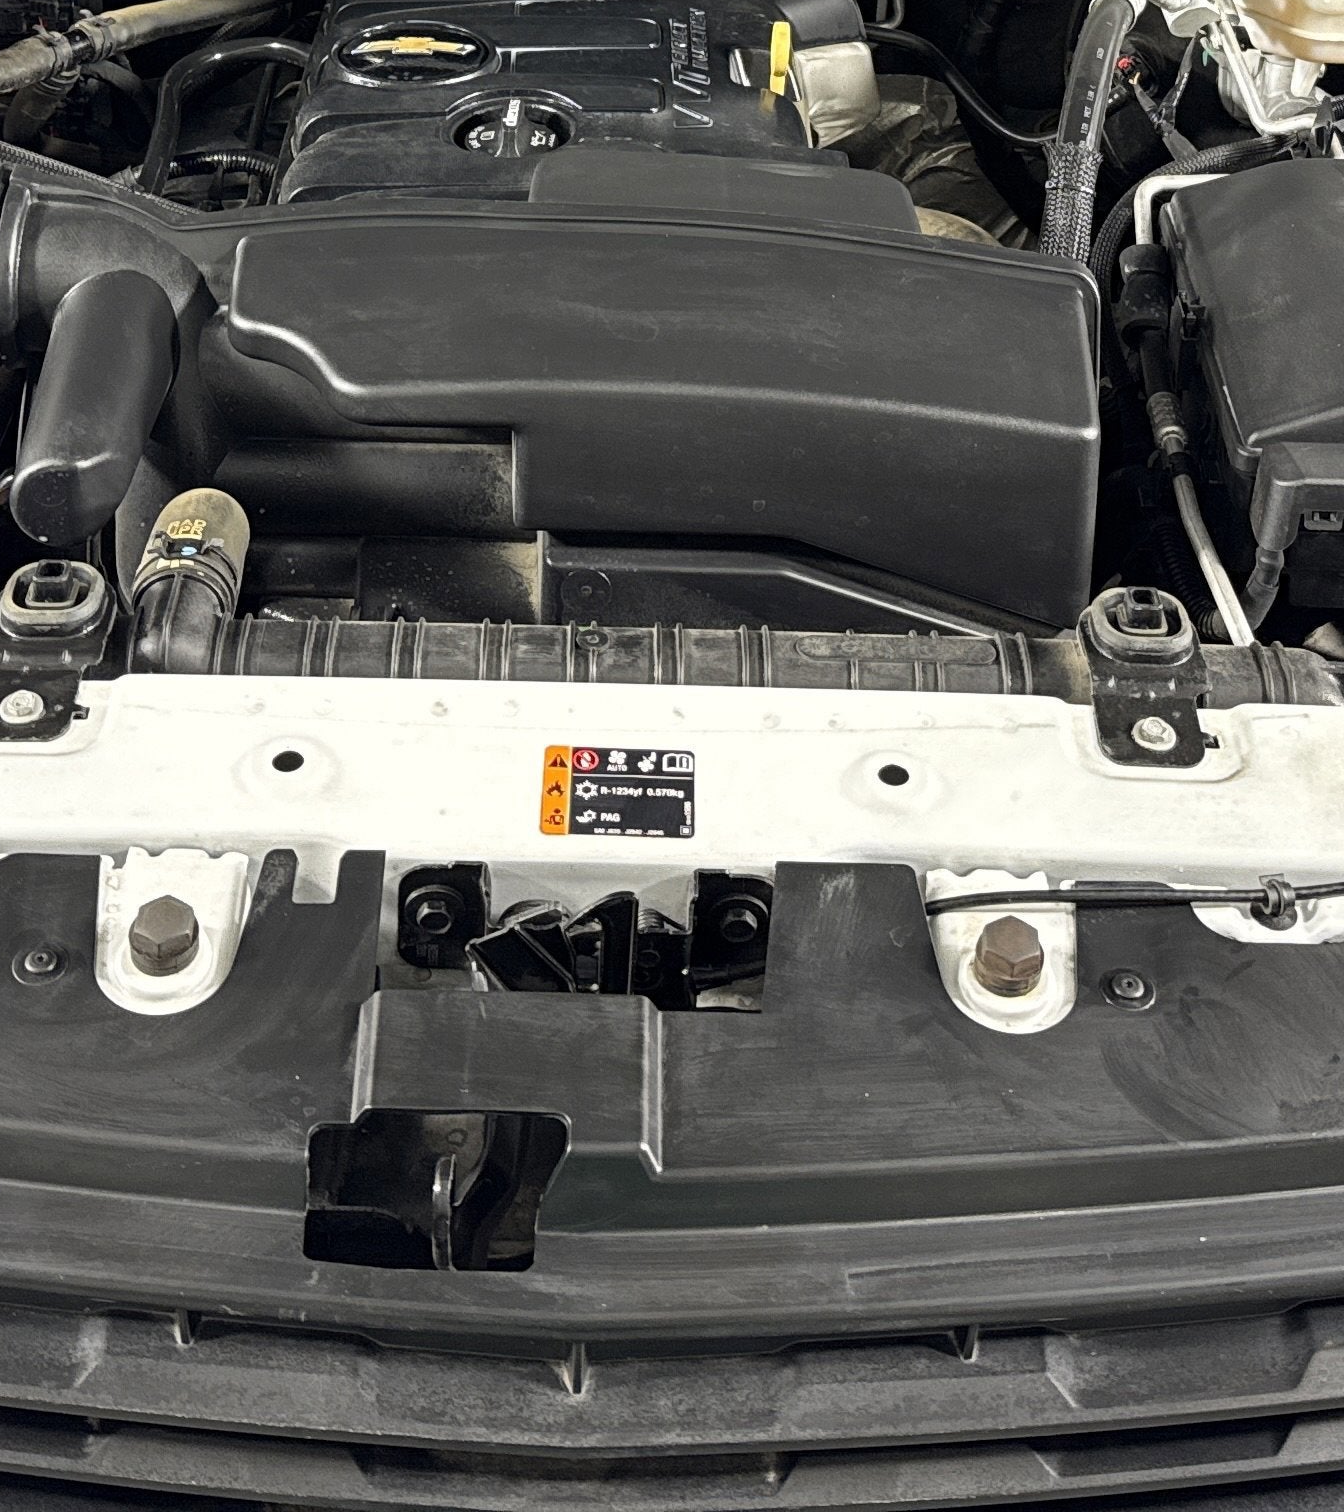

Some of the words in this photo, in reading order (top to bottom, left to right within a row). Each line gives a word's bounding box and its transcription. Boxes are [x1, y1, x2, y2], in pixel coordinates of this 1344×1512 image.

[606, 764, 628, 772] AUTO
[599, 786, 643, 797] R-1234yf
[599, 812, 621, 823] PAG
